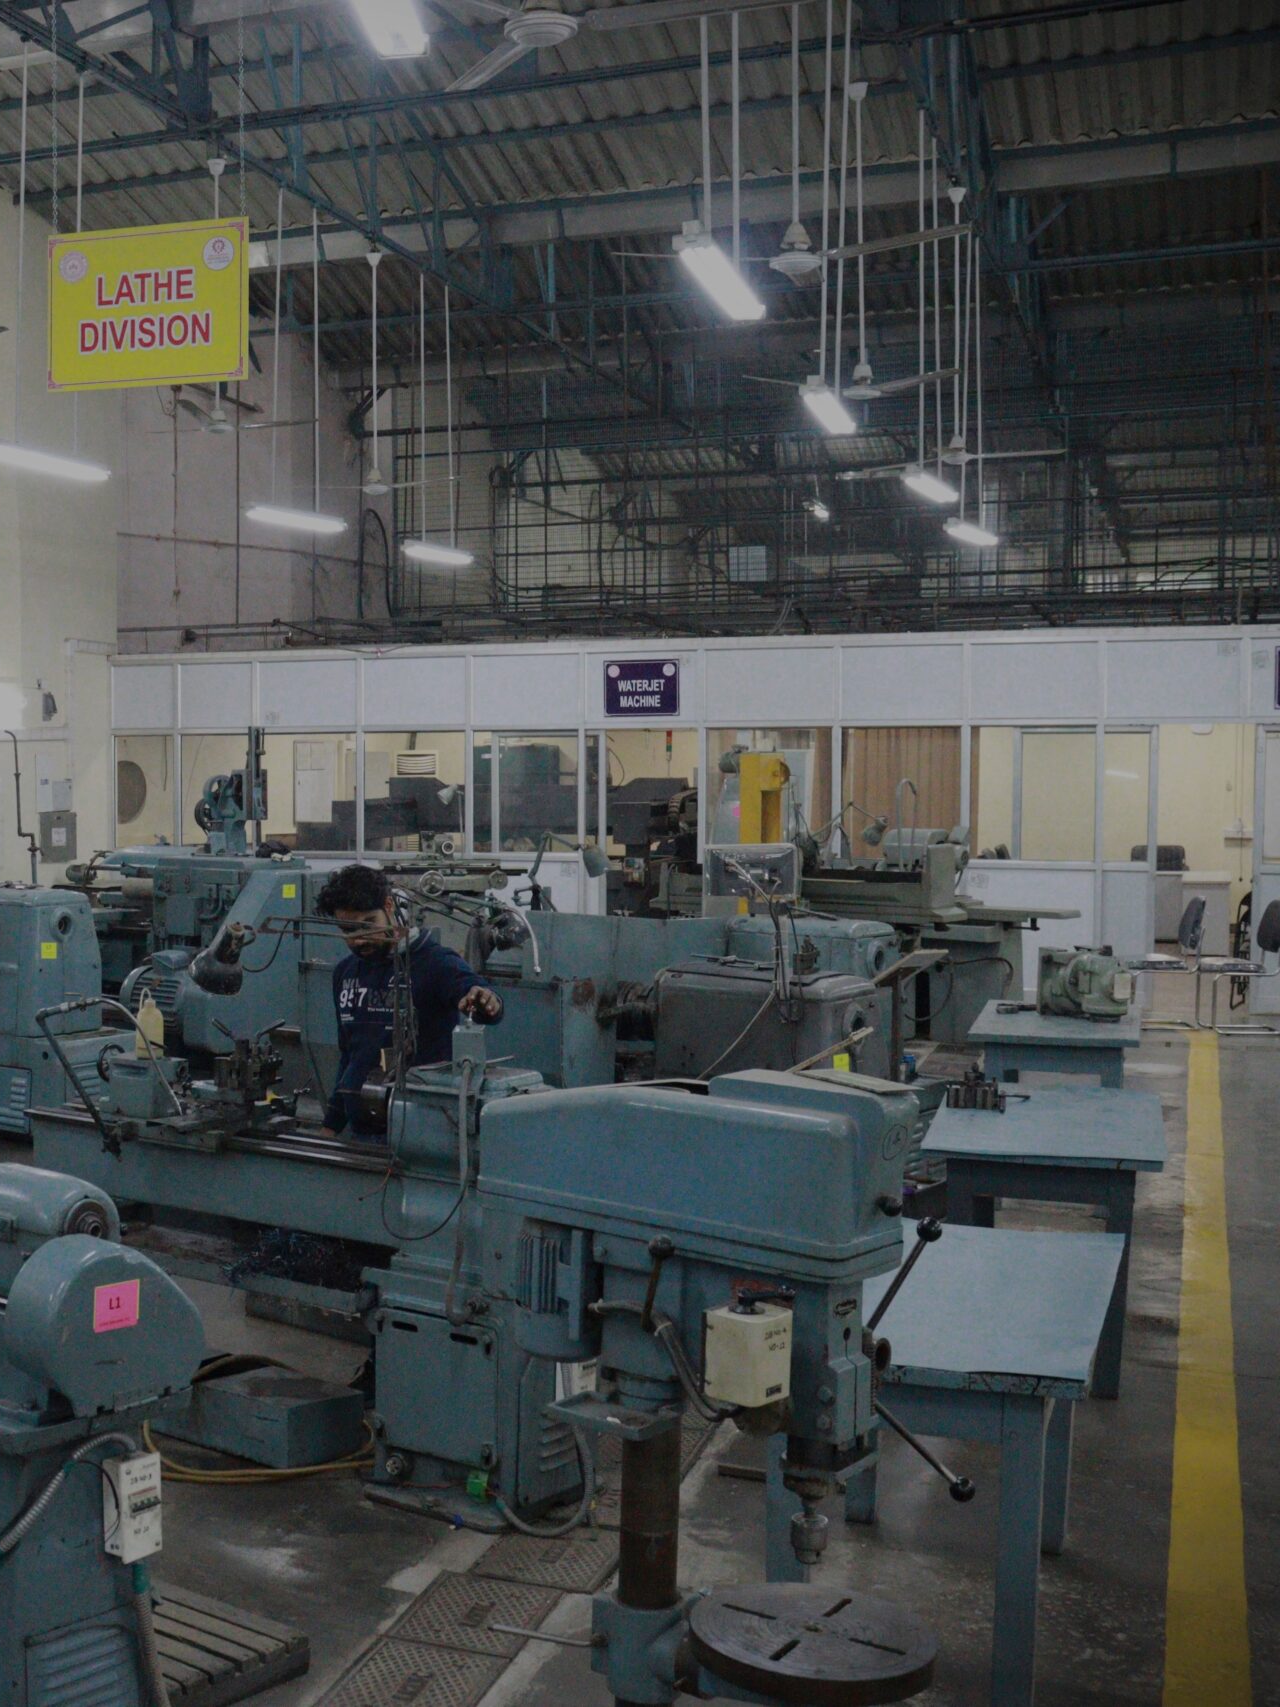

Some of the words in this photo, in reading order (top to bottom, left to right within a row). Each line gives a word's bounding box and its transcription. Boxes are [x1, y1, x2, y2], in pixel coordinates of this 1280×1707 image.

[96, 269, 194, 307] LATHE
[80, 313, 211, 353] DIVISION
[617, 679, 666, 692] WATERJET
[619, 695, 662, 708] MACHINE
[109, 1296, 121, 1310] L1
